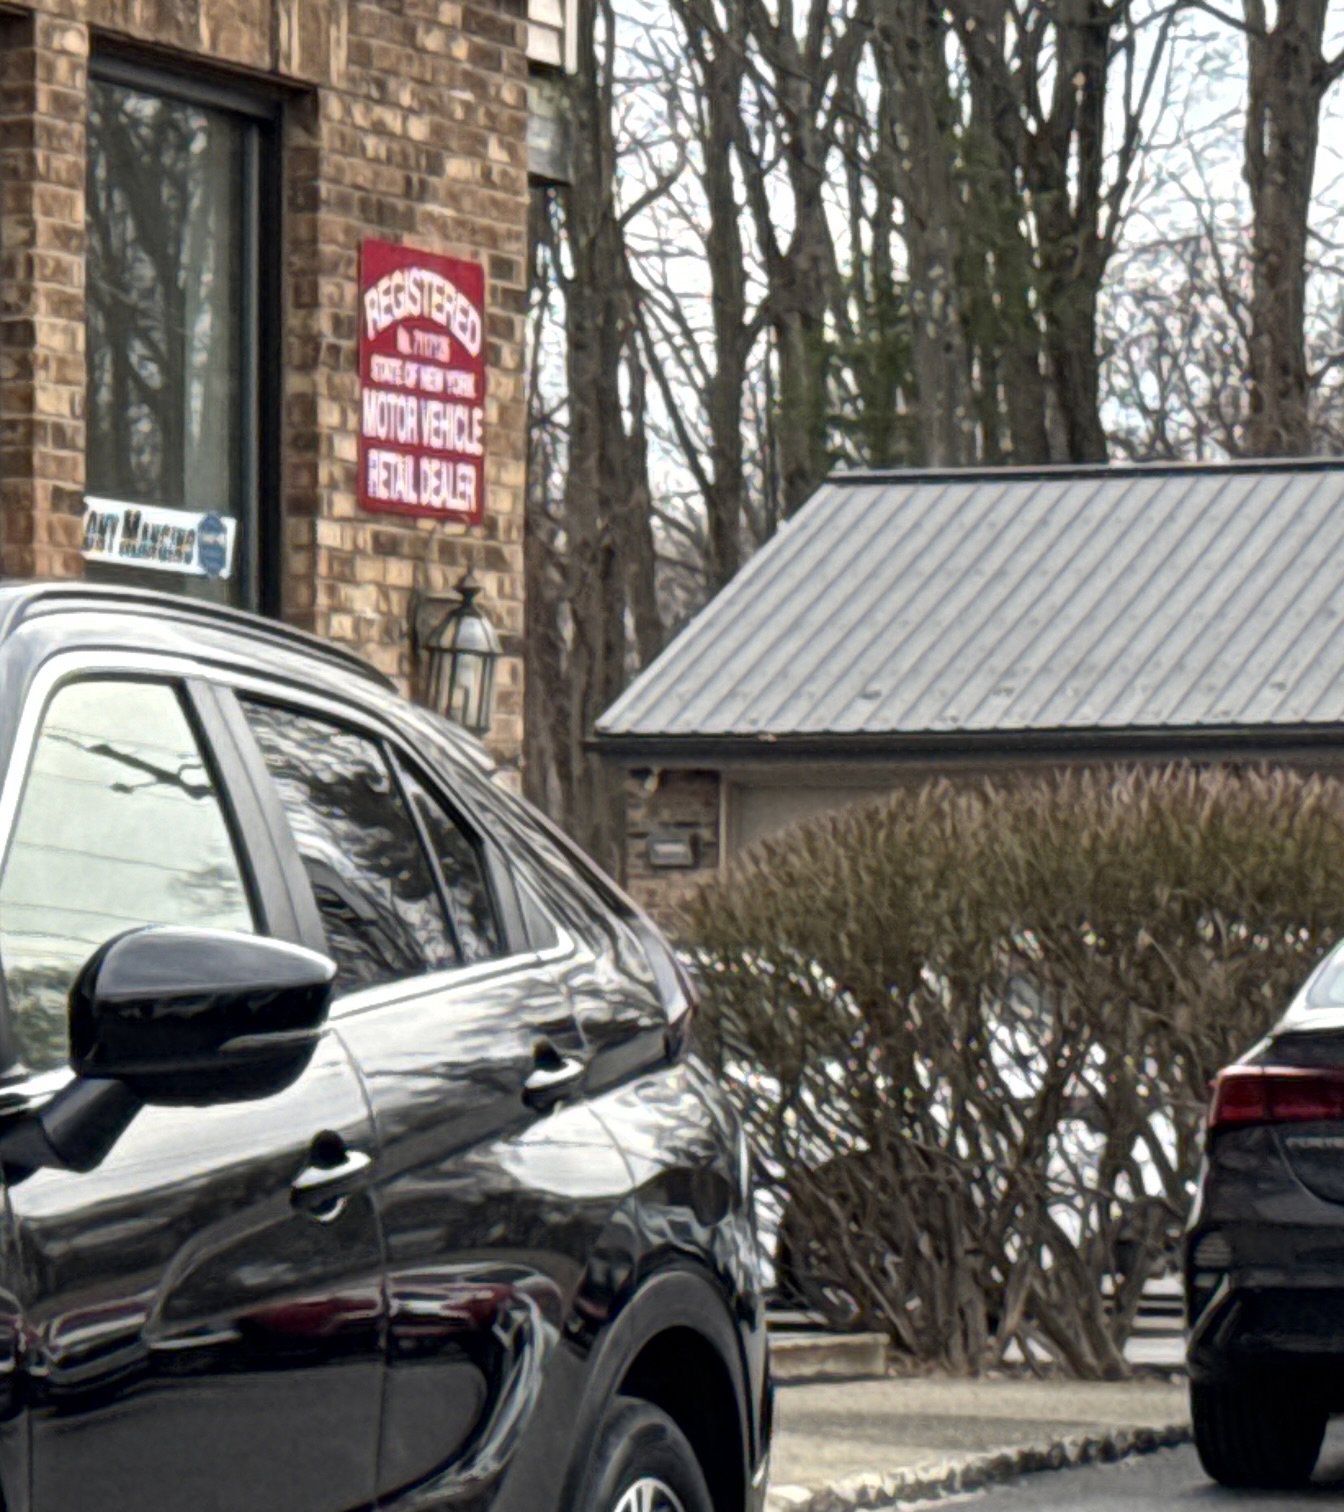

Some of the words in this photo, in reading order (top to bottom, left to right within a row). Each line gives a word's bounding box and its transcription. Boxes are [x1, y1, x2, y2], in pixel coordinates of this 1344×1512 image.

[364, 267, 481, 357] REGISTERED
[363, 387, 419, 446] MOTOR
[420, 397, 483, 457] VEHICLE
[368, 448, 418, 505] RETAIL
[420, 456, 477, 513] DEALER
[81, 510, 120, 554] ONY
